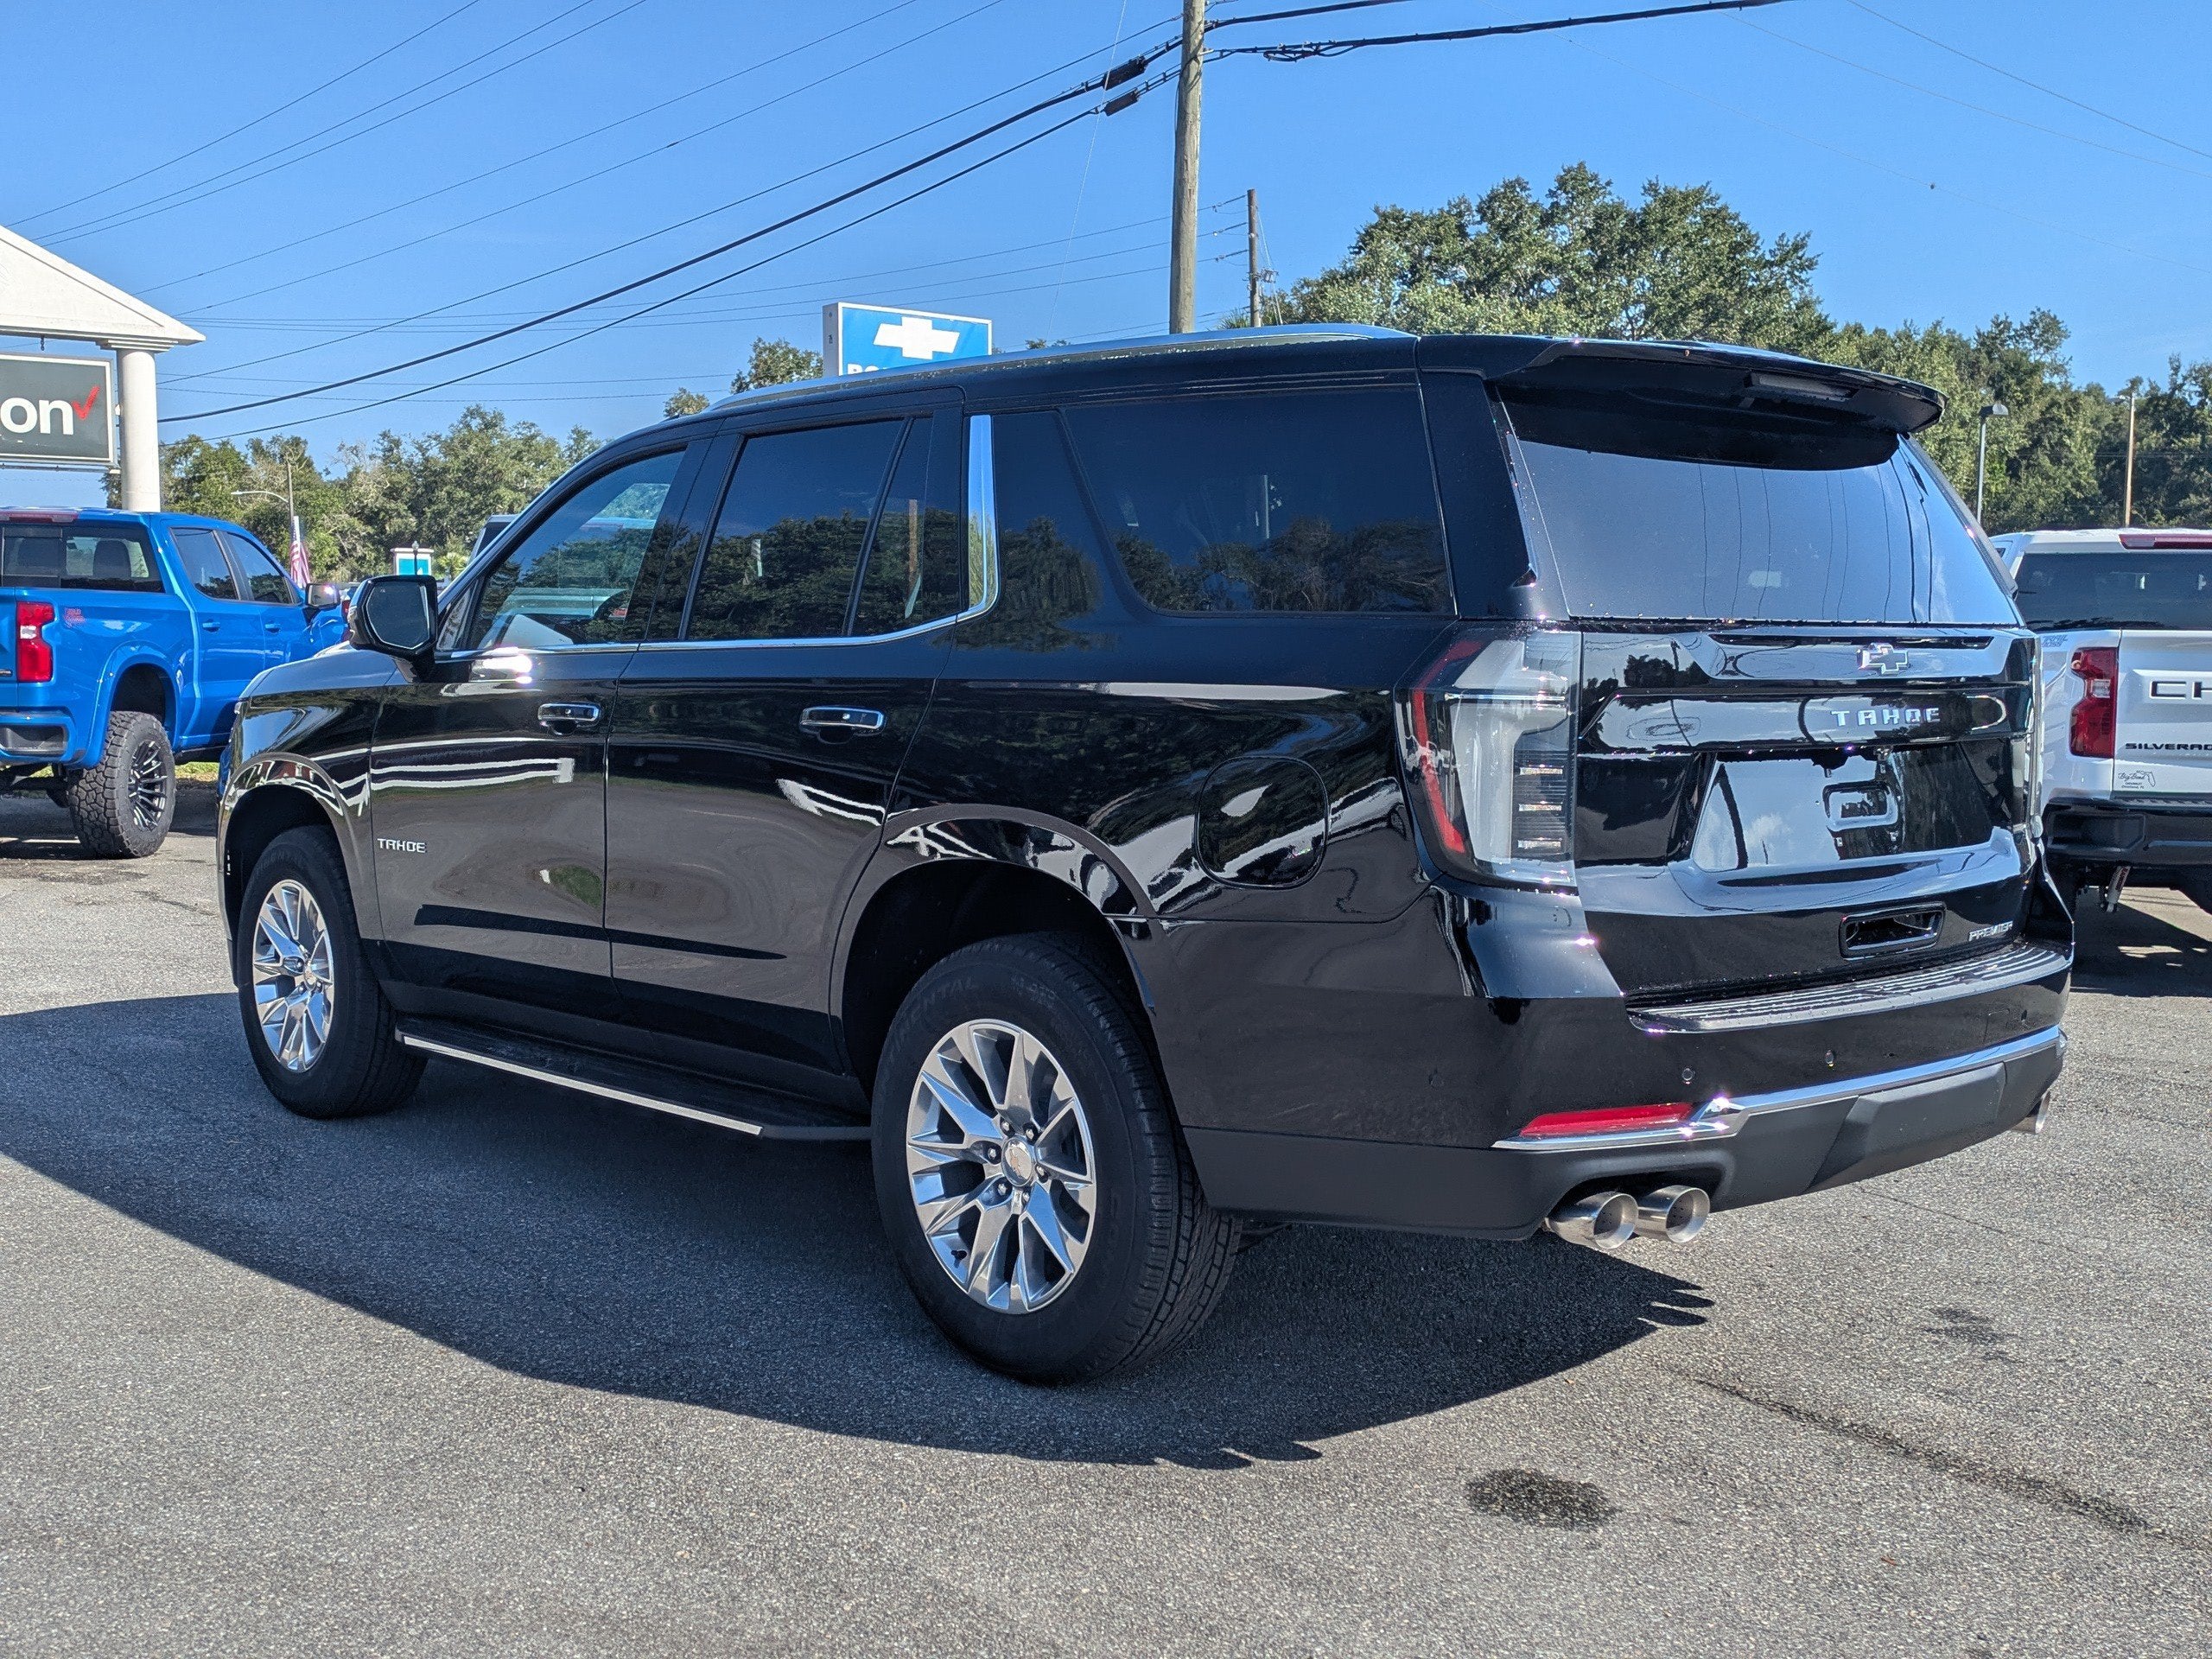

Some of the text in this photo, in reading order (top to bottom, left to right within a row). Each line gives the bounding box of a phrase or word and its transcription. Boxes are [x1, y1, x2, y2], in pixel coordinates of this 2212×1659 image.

[0, 397, 74, 435] on
[1830, 708, 1941, 727] TAHOE
[378, 838, 427, 854] TAHOE
[1968, 920, 2013, 942] PREMIER
